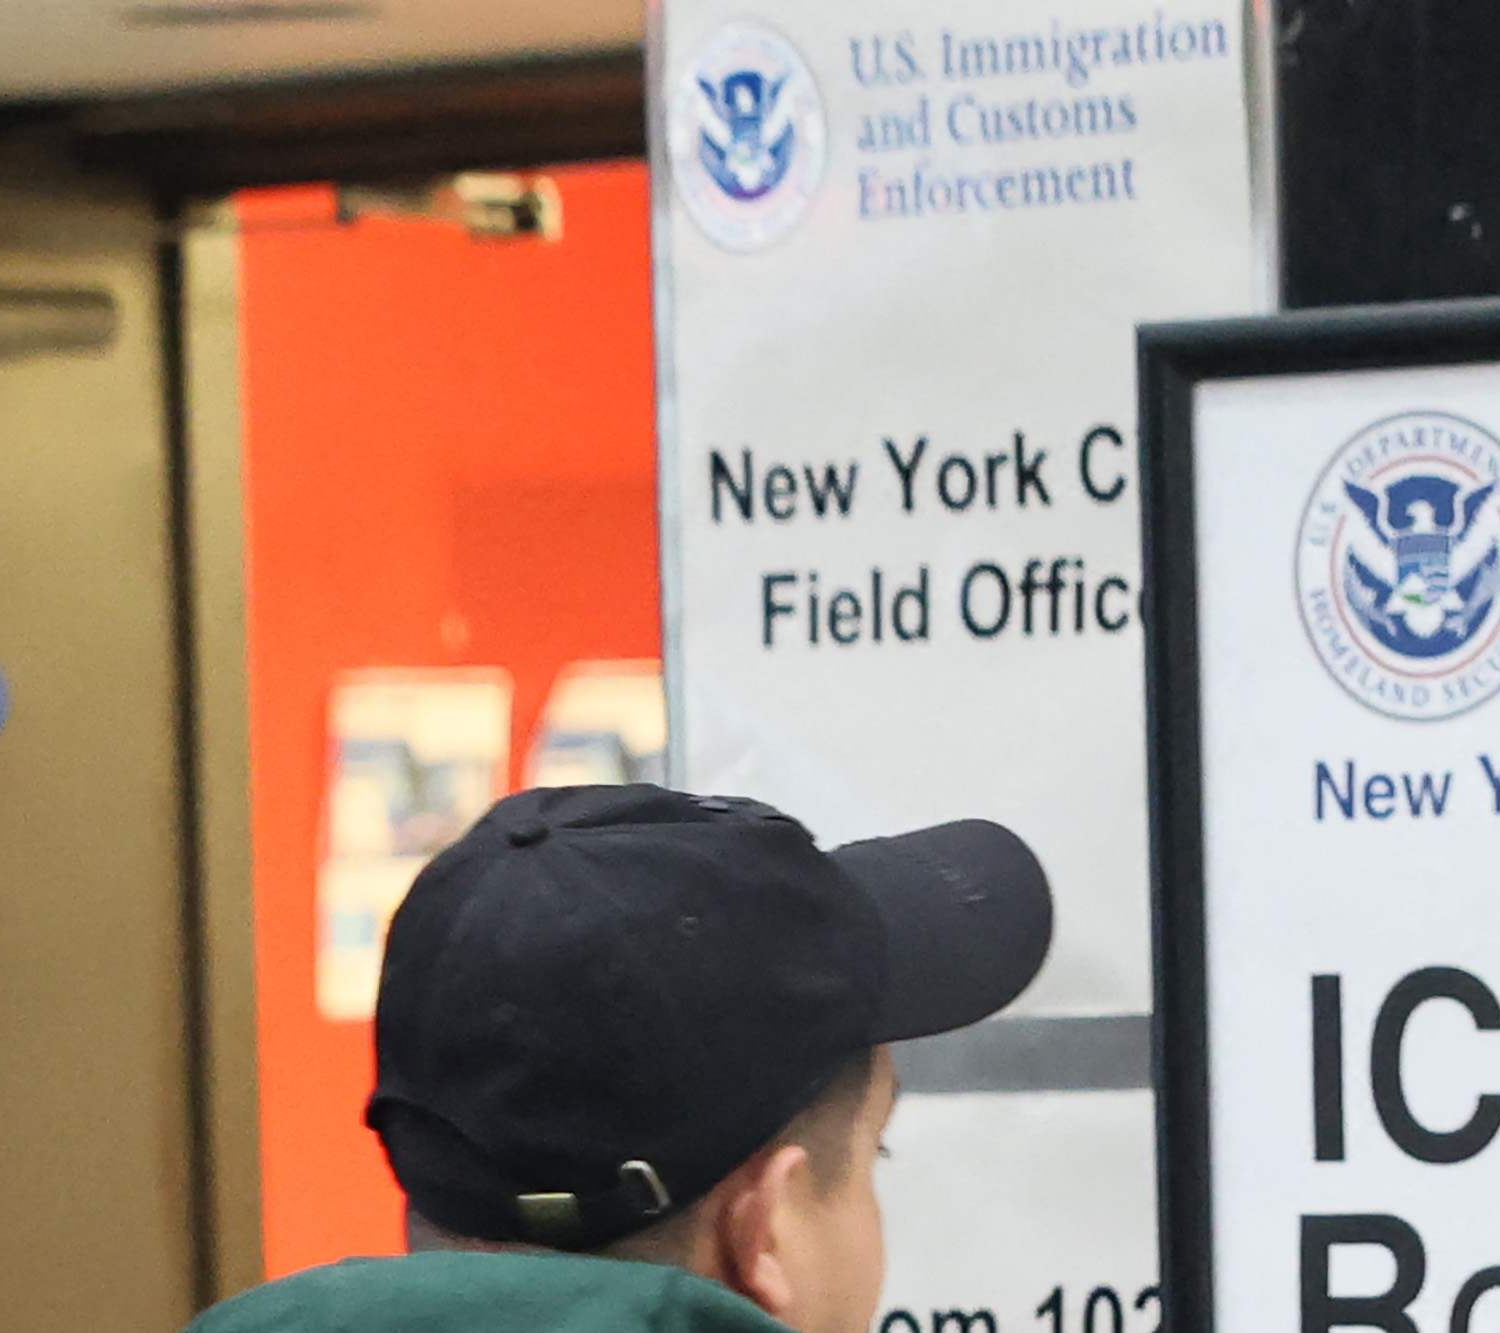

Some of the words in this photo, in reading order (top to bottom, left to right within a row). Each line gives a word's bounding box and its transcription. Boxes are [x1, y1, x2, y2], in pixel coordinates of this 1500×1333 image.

[941, 11, 1229, 89] Immigration
[856, 94, 931, 153] and
[947, 90, 1138, 145] Customs
[857, 157, 1137, 220] Enforcement
[709, 447, 859, 524] New
[883, 430, 1052, 515] York
[761, 565, 931, 649] Field
[959, 556, 1145, 640] Offic
[1314, 759, 1453, 822] New
